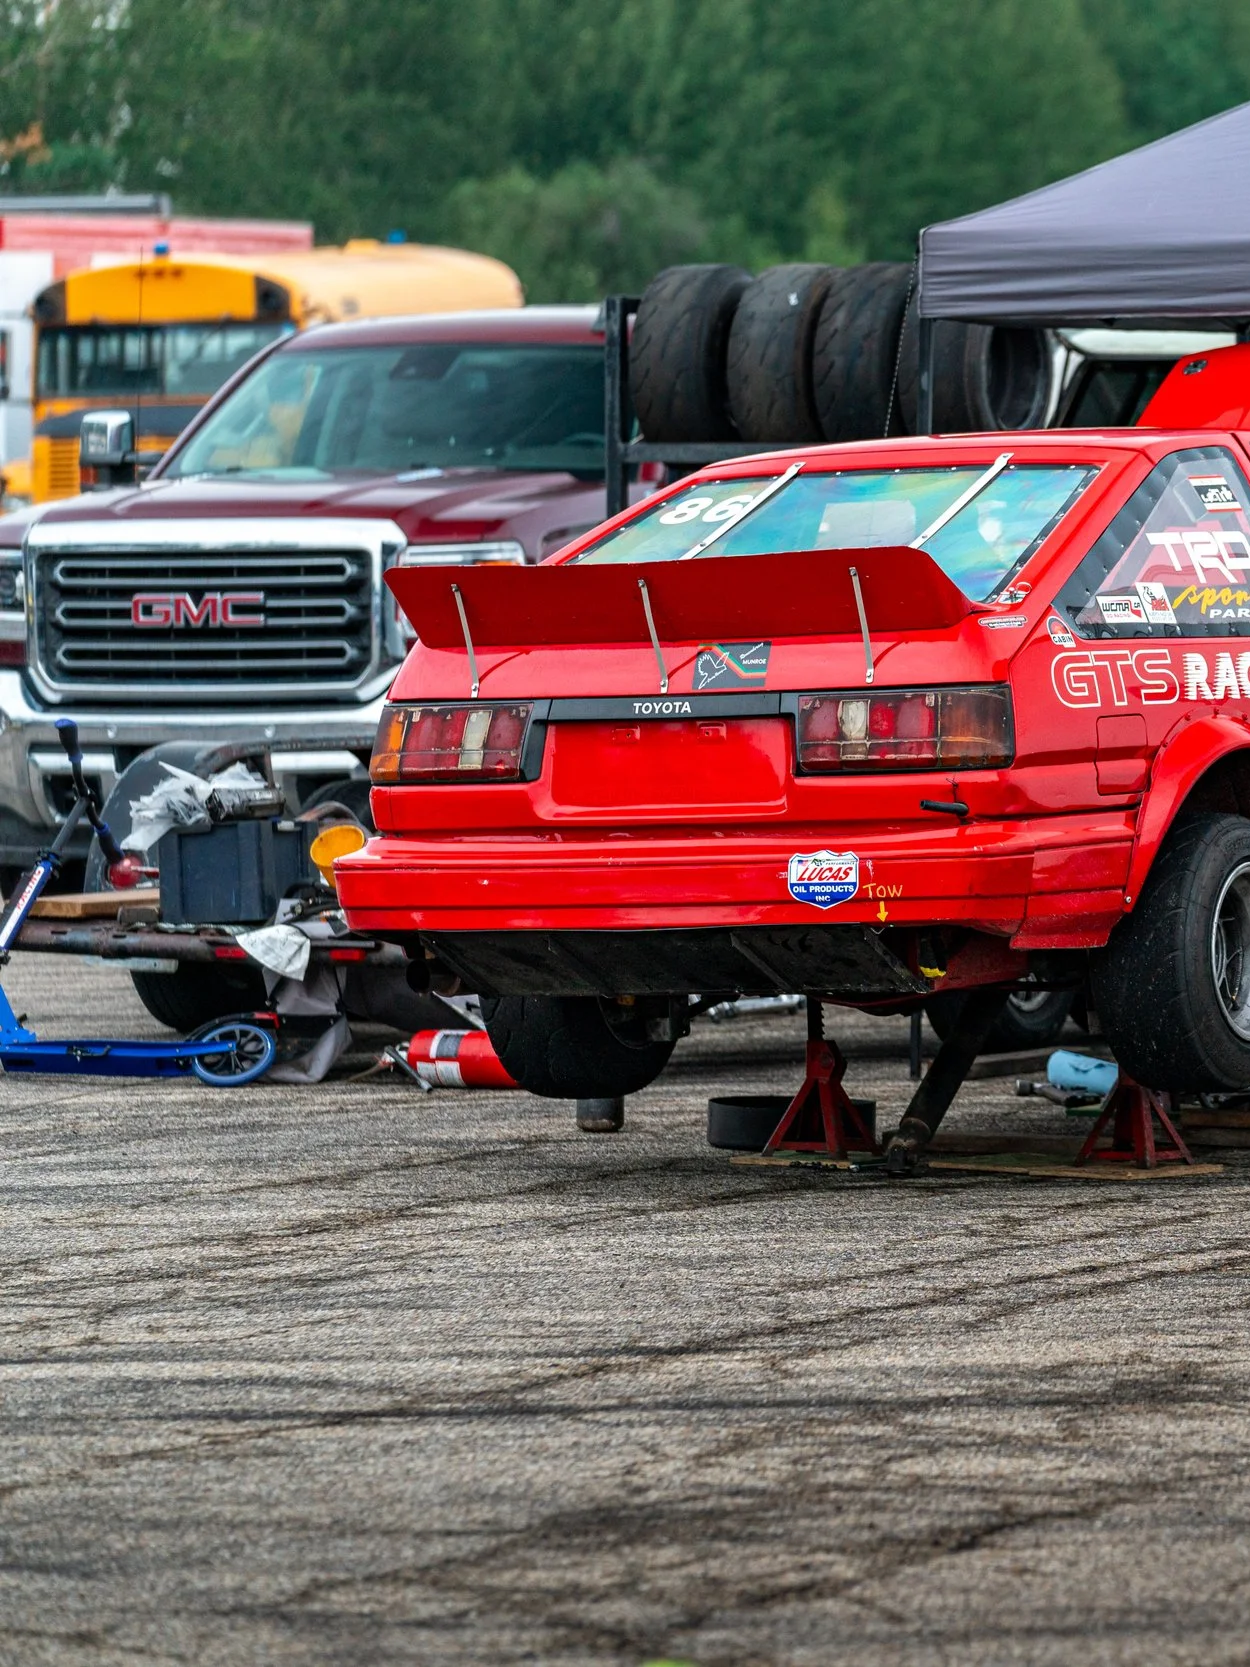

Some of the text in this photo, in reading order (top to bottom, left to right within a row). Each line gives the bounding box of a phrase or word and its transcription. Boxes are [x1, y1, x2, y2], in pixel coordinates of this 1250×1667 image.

[659, 494, 754, 525] 86
[131, 592, 265, 628] GMC
[1052, 635, 1073, 643] CABIN
[1050, 649, 1180, 709] GTS
[633, 701, 692, 715] TOYOTA
[796, 866, 853, 882] LUCAS
[792, 884, 855, 893] OIL PRODUCTS
[862, 883, 903, 900] TOW
